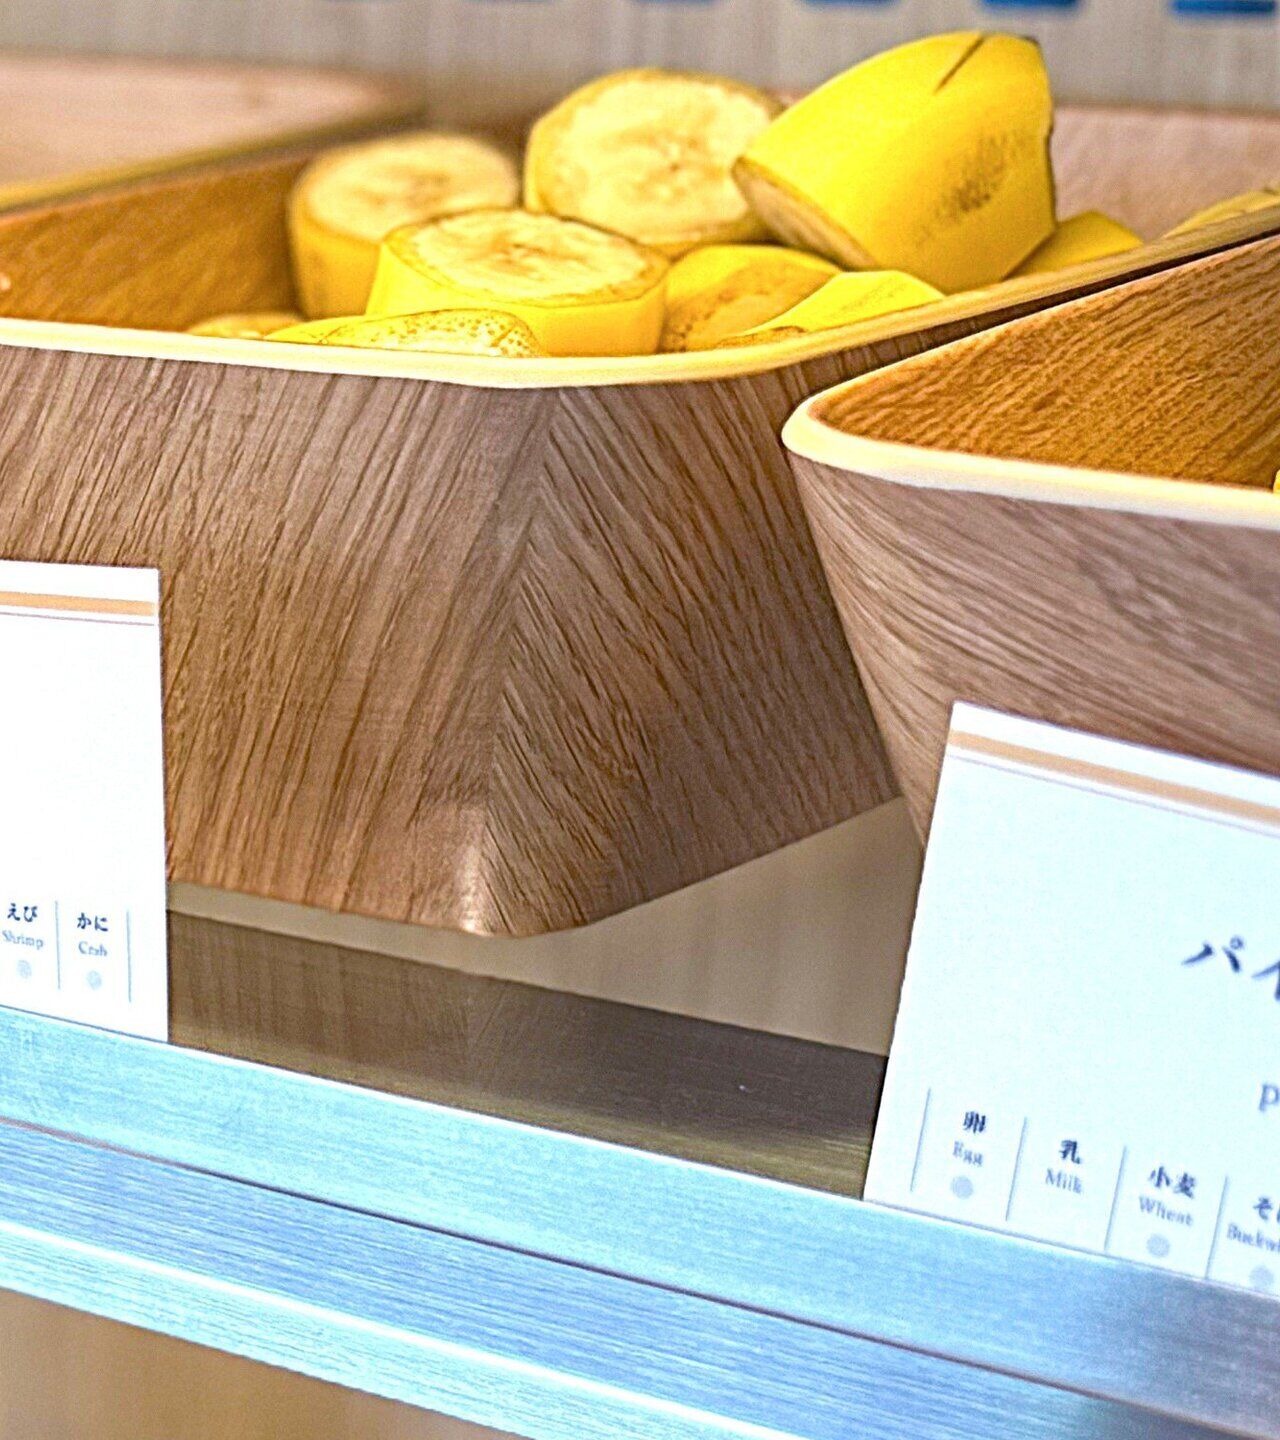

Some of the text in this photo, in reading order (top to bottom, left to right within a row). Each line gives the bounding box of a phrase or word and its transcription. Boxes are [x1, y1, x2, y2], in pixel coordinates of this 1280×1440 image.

[6, 902, 38, 923] えび
[77, 912, 109, 932] かに
[2, 930, 45, 950] Shrimp
[962, 1110, 1280, 1223] 卵 乳 小麦 そ
[1045, 1167, 1083, 1195] Milk
[1139, 1195, 1194, 1227] Wheat
